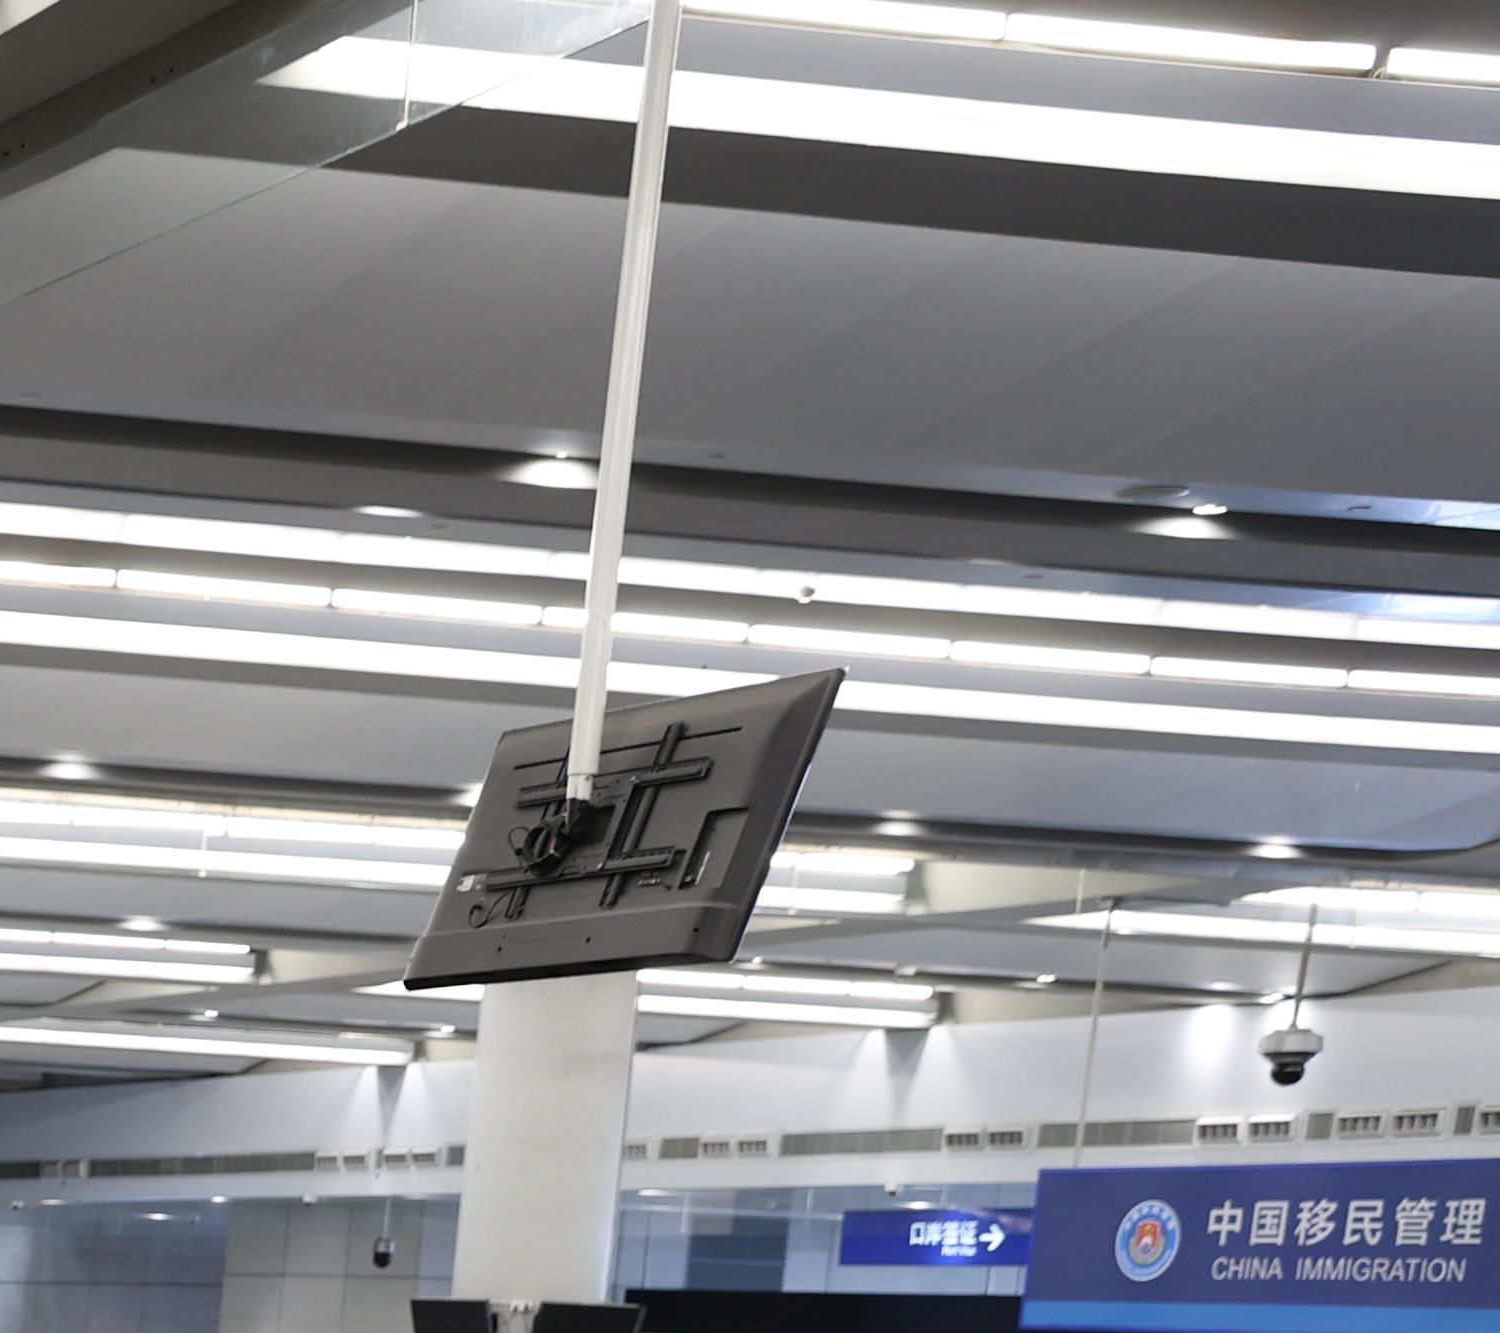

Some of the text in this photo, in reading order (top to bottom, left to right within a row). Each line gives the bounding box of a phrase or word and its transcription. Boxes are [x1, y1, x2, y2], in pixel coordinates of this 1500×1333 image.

[1206, 1196, 1487, 1248] 中国移民管理
[1210, 1255, 1467, 1283] CHINA IMMIGRATION
